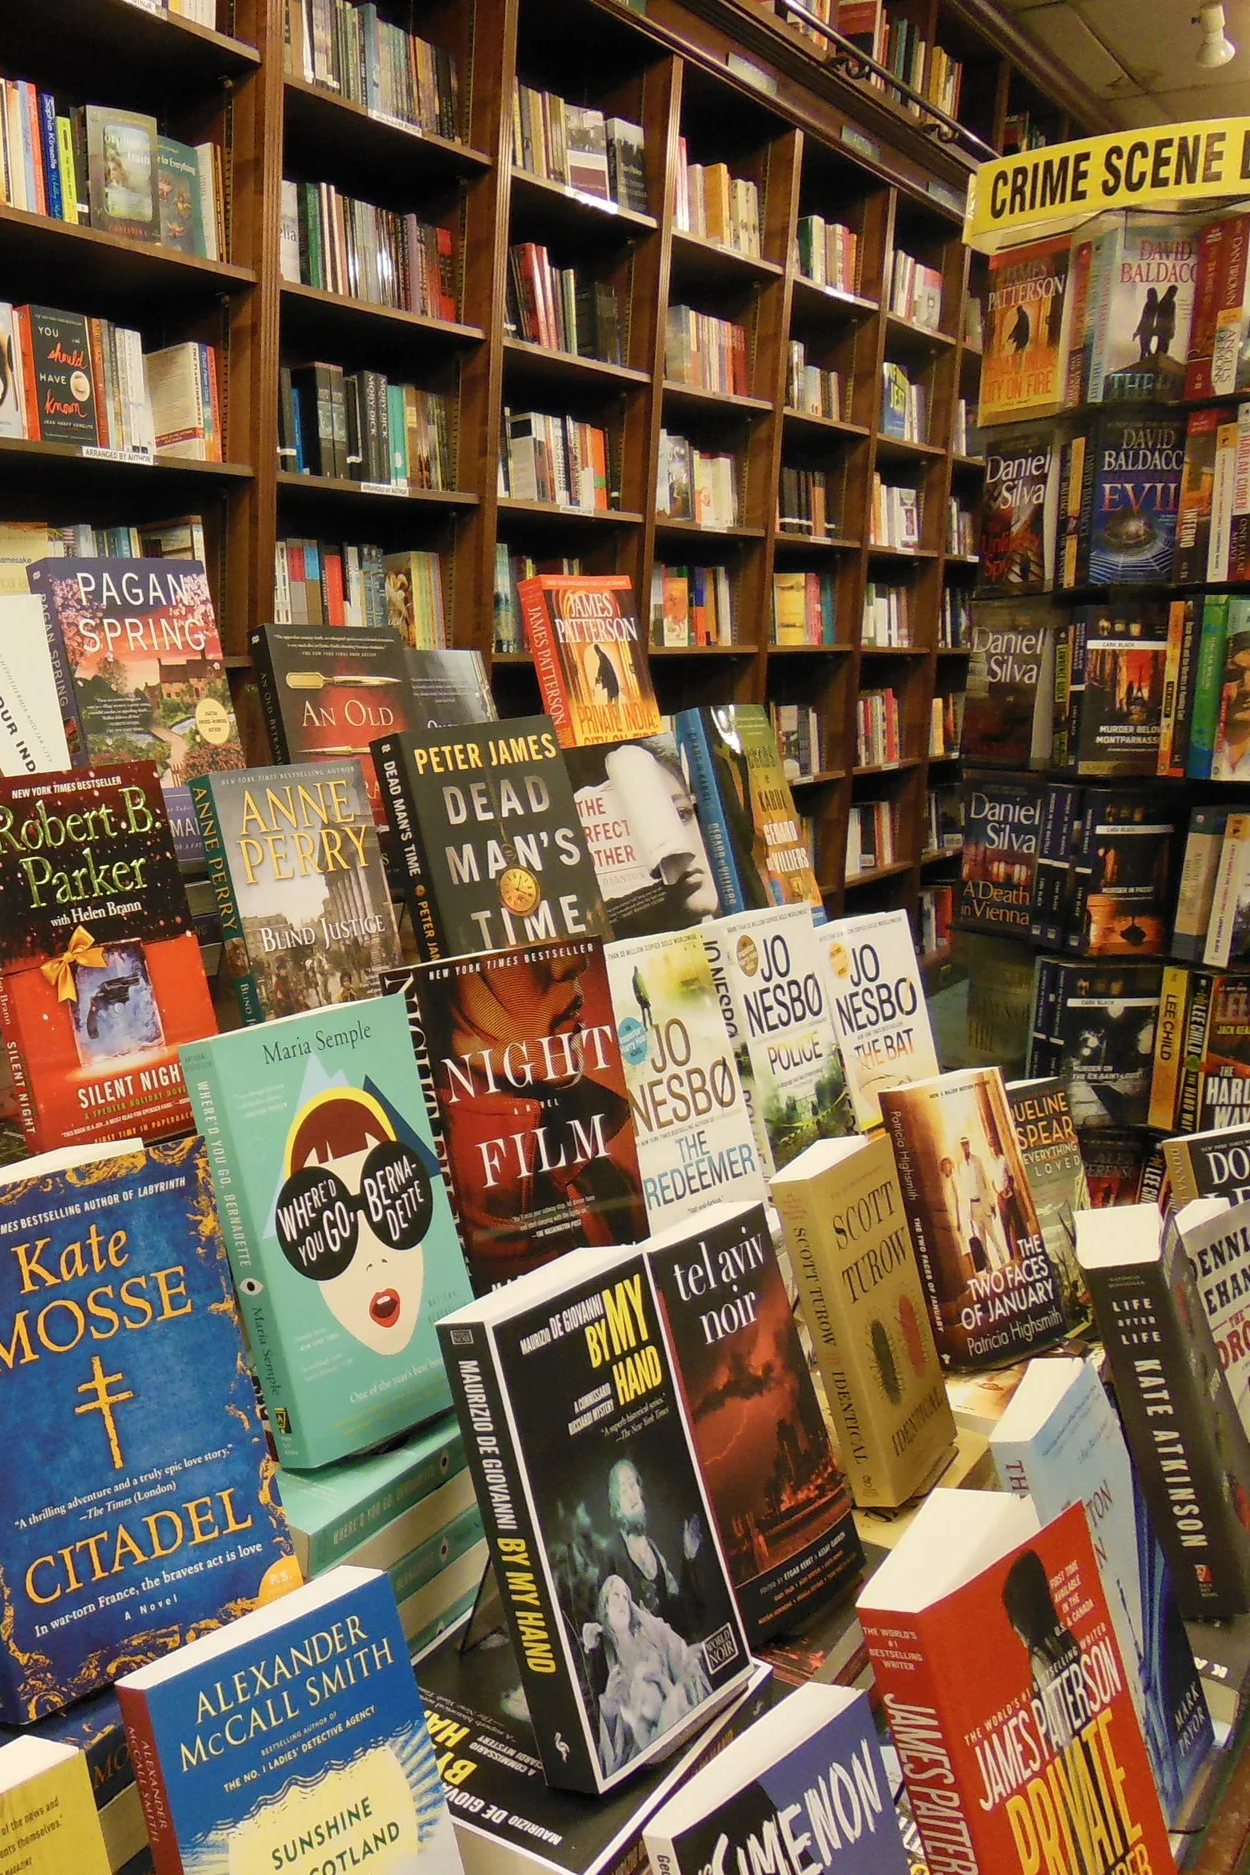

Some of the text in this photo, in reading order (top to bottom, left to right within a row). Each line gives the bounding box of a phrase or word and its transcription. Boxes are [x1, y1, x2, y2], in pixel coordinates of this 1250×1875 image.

[990, 132, 1226, 220] CRIME SCENE
[37, 327, 59, 338] YOU
[48, 343, 87, 369] should
[39, 373, 67, 385] HAVE
[45, 389, 87, 418] known
[85, 450, 116, 460] ARRANGED
[1102, 450, 1183, 471] BALDACC
[1122, 429, 1175, 450] DAVID
[986, 454, 1054, 484] Daniel
[999, 482, 1045, 510] Silva
[76, 572, 189, 608] PAGAN
[570, 593, 612, 618] JAMES
[80, 617, 206, 654] SPRING
[554, 618, 638, 642] PATTERSON
[414, 733, 557, 776] PETER JAMES
[120, 785, 163, 836] B.
[239, 780, 357, 837] ANNE
[442, 779, 551, 826] DEAD
[970, 792, 1042, 826] Daniel
[235, 826, 371, 887] PERRY
[445, 828, 582, 886] MAN'S
[985, 823, 1037, 854] Silva
[21, 848, 148, 909] Parker
[962, 880, 1031, 906] A Death
[50, 901, 143, 929] with Helen Brann
[259, 913, 387, 953] BLIND JUSTICE
[471, 894, 588, 950] TIME
[960, 901, 1031, 925] in Vienna
[760, 934, 791, 983] JO
[744, 971, 823, 1036] NESBØ
[1160, 993, 1177, 1061] LEE CHILD
[262, 1023, 372, 1066] Maria Semple
[442, 1025, 613, 1101] NIGHT
[651, 1018, 691, 1073] JO
[768, 1036, 823, 1075] POLICE
[883, 1029, 917, 1057] BAT
[630, 1057, 736, 1137] NESBØ
[476, 1114, 612, 1188] FILM
[675, 1131, 710, 1165] THE
[1021, 1142, 1078, 1165] EVERYTHING
[1034, 1156, 1082, 1179] LOVED
[364, 1156, 418, 1222] BERNA-
[643, 1144, 756, 1210] REDEEMER
[20, 1203, 82, 1229] BESTSELLING
[84, 1193, 120, 1214] AUTHOR
[122, 1190, 136, 1201] OF
[138, 1176, 187, 1198] LABYRINTH
[278, 1177, 337, 1244] WHERE'D
[386, 1189, 424, 1241] DETTE
[832, 1181, 895, 1250] SCOTT
[298, 1201, 355, 1265] YOU GO,
[1017, 1239, 1043, 1257] THE
[11, 1224, 130, 1294] Kate
[673, 1226, 766, 1302] tel aviv
[841, 1227, 909, 1304] TUROW
[967, 1258, 1051, 1300] TWO FACES
[585, 1273, 648, 1369] BY MY
[699, 1291, 760, 1346] noir
[960, 1280, 1055, 1329] OF JANUARY
[966, 1311, 1064, 1357] Patricia Highsmith
[611, 1346, 663, 1407] HAND
[1134, 1359, 1208, 1548] KATE ATKINSON
[24, 1487, 253, 1606] CITADEL
[195, 1614, 369, 1726] ALEXANDER
[179, 1637, 394, 1773] McCALL SMITH
[978, 1635, 1121, 1811] JAMES PATTERSON
[1173, 1682, 1201, 1727] MARK
[270, 1796, 373, 1871] SUNSHINE
